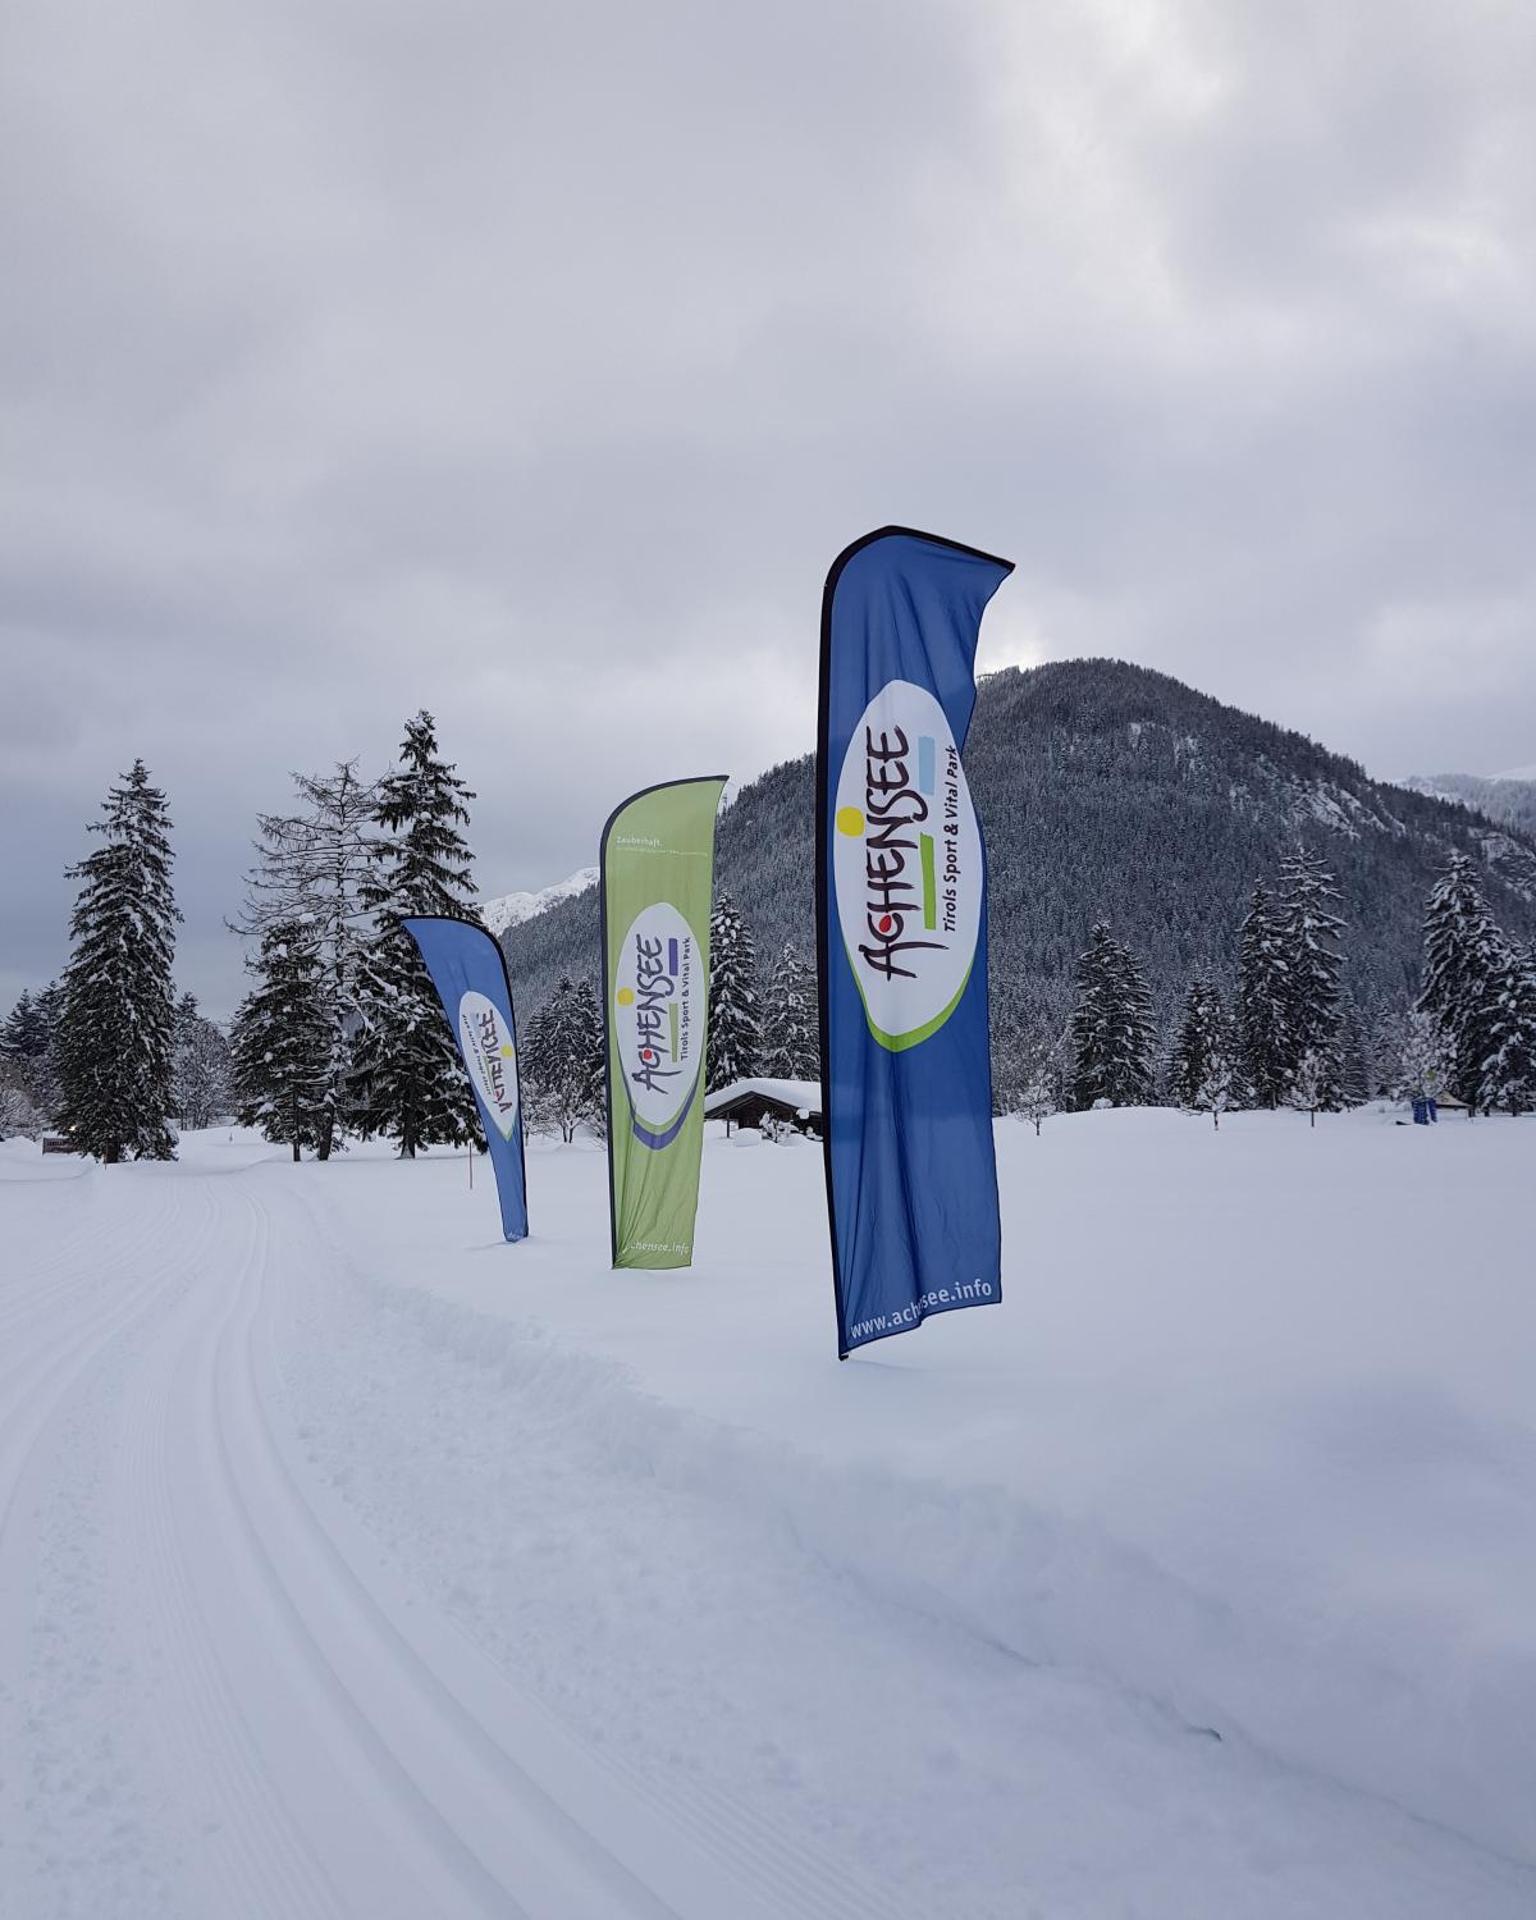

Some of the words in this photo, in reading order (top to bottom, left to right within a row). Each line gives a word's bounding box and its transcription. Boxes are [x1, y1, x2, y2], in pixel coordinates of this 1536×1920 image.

[943, 745, 957, 778] Park
[943, 781, 959, 821] Vital
[944, 824, 959, 836] &
[858, 724, 949, 981] ACHENSEE
[943, 838, 961, 884] Sport
[944, 889, 957, 932] Tirols
[681, 963, 691, 987] Vital
[681, 988, 691, 997] &
[632, 933, 683, 1095] ACHENSEE
[680, 1001, 691, 1029] Sport
[680, 1031, 689, 1061] Tirols
